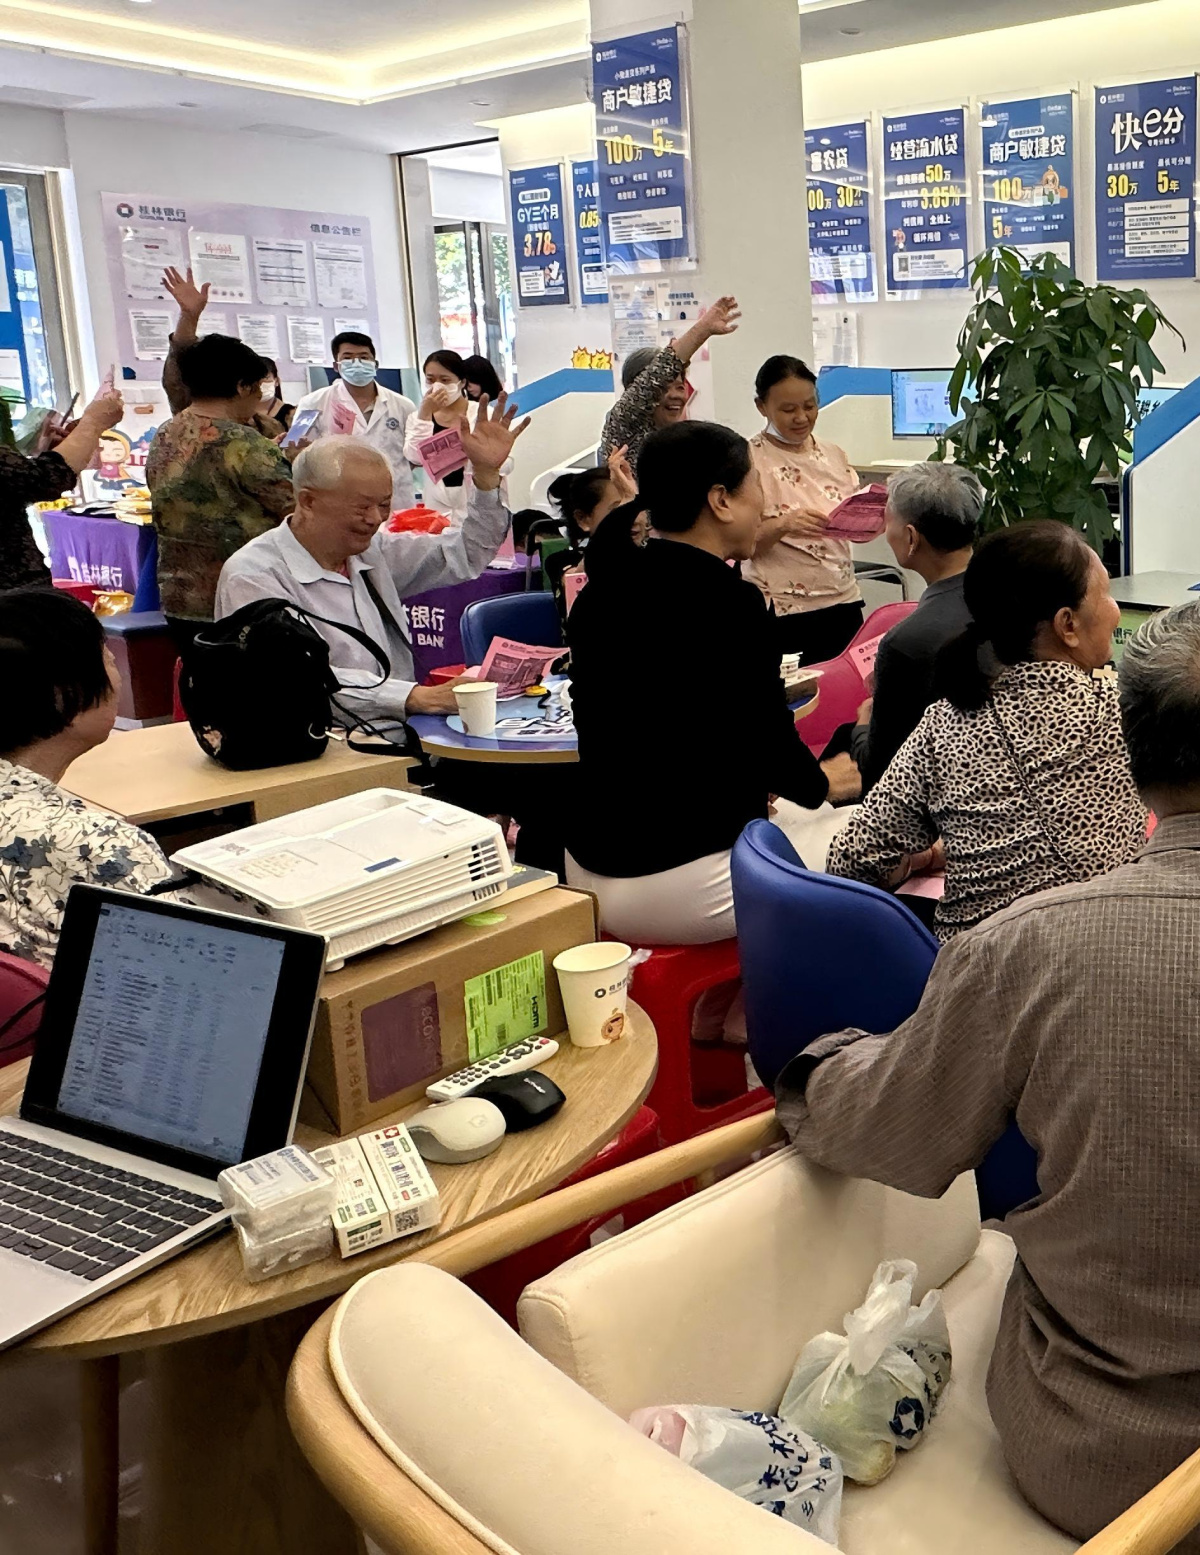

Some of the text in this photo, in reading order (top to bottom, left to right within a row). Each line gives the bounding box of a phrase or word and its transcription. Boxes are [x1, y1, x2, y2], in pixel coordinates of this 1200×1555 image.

[602, 78, 672, 112] 商户敏捷贷
[652, 128, 674, 158] 5年
[1111, 106, 1185, 155] 快e分
[605, 134, 643, 165] 100万
[890, 134, 958, 161] 经营流水贷
[989, 134, 1066, 164] 商户敏捷贷
[920, 185, 961, 210] 3.85%
[1107, 170, 1180, 198] 30万 5年
[517, 204, 559, 223] GY三个月
[992, 215, 1013, 239] 5年
[310, 223, 362, 236] 信息公告栏
[417, 633, 445, 649] BANK
